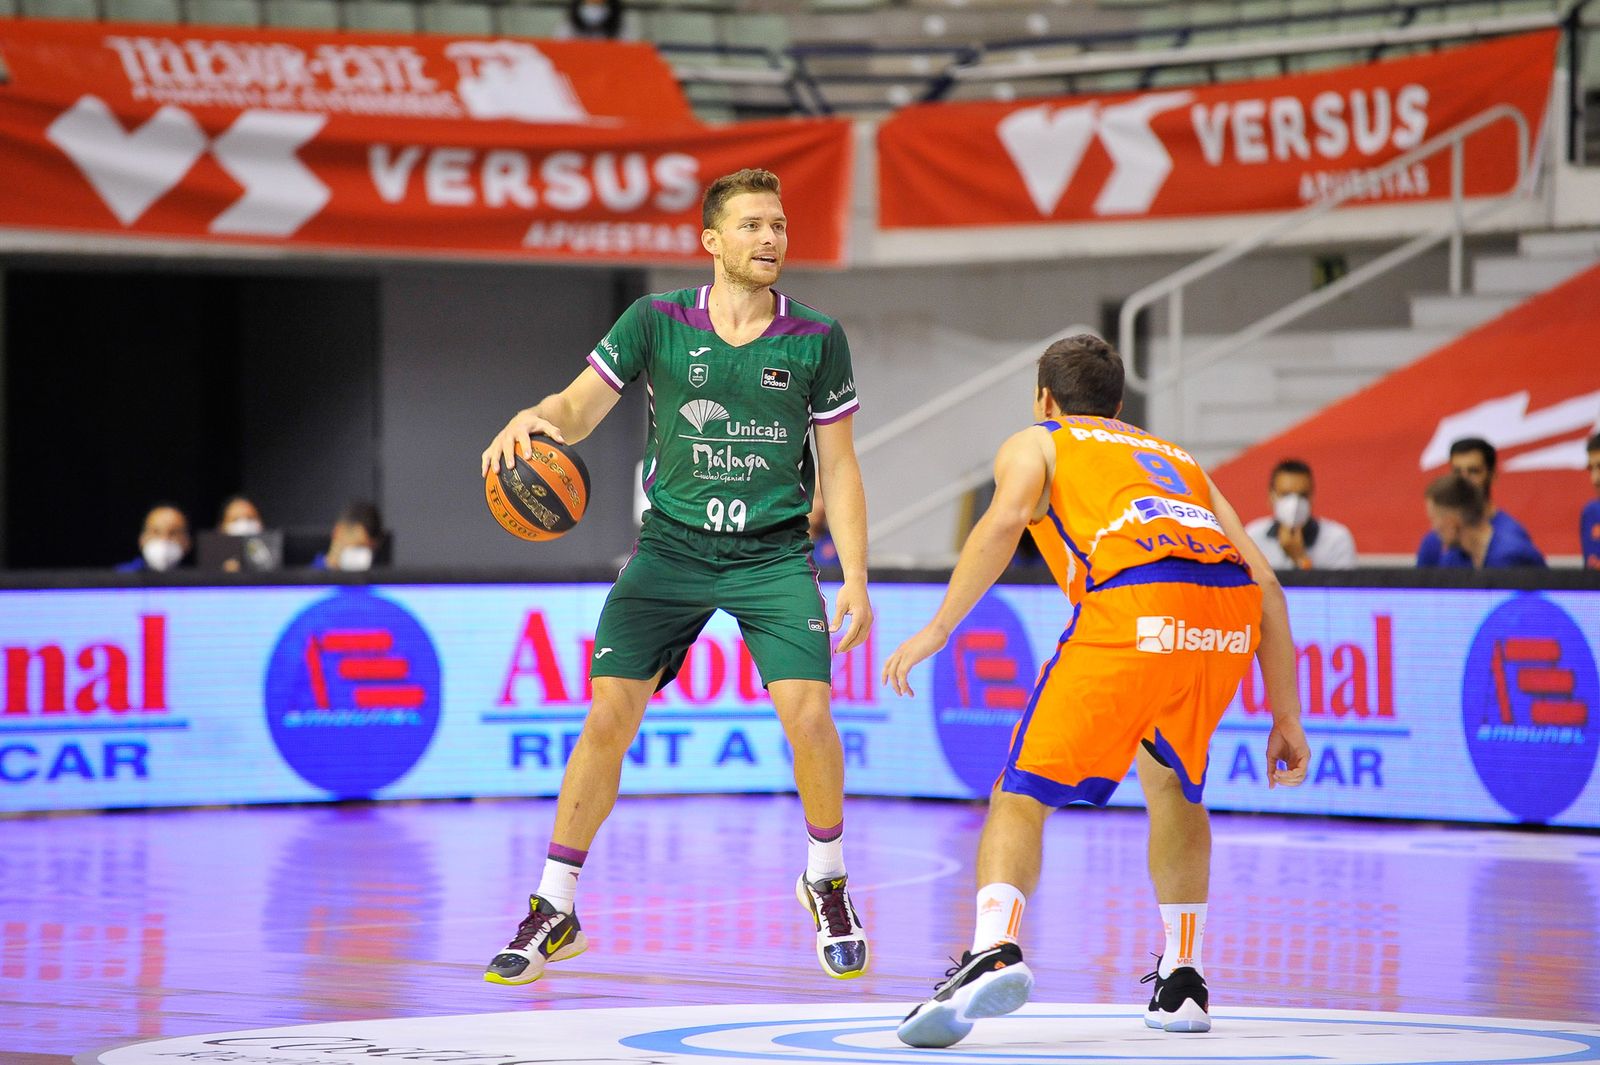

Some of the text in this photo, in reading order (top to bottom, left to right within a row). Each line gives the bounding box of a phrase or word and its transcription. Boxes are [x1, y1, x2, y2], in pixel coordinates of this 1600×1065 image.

[1190, 84, 1430, 166] VERSUS
[367, 144, 699, 213] VERSUS
[726, 419, 787, 440] Unicaja
[692, 443, 770, 478] Málaga
[1132, 450, 1191, 495] 9
[703, 497, 747, 532] 99
[1177, 619, 1251, 654] isaval
[0, 743, 150, 783] CAR
[715, 729, 758, 767] A
[1227, 743, 1258, 781] A
